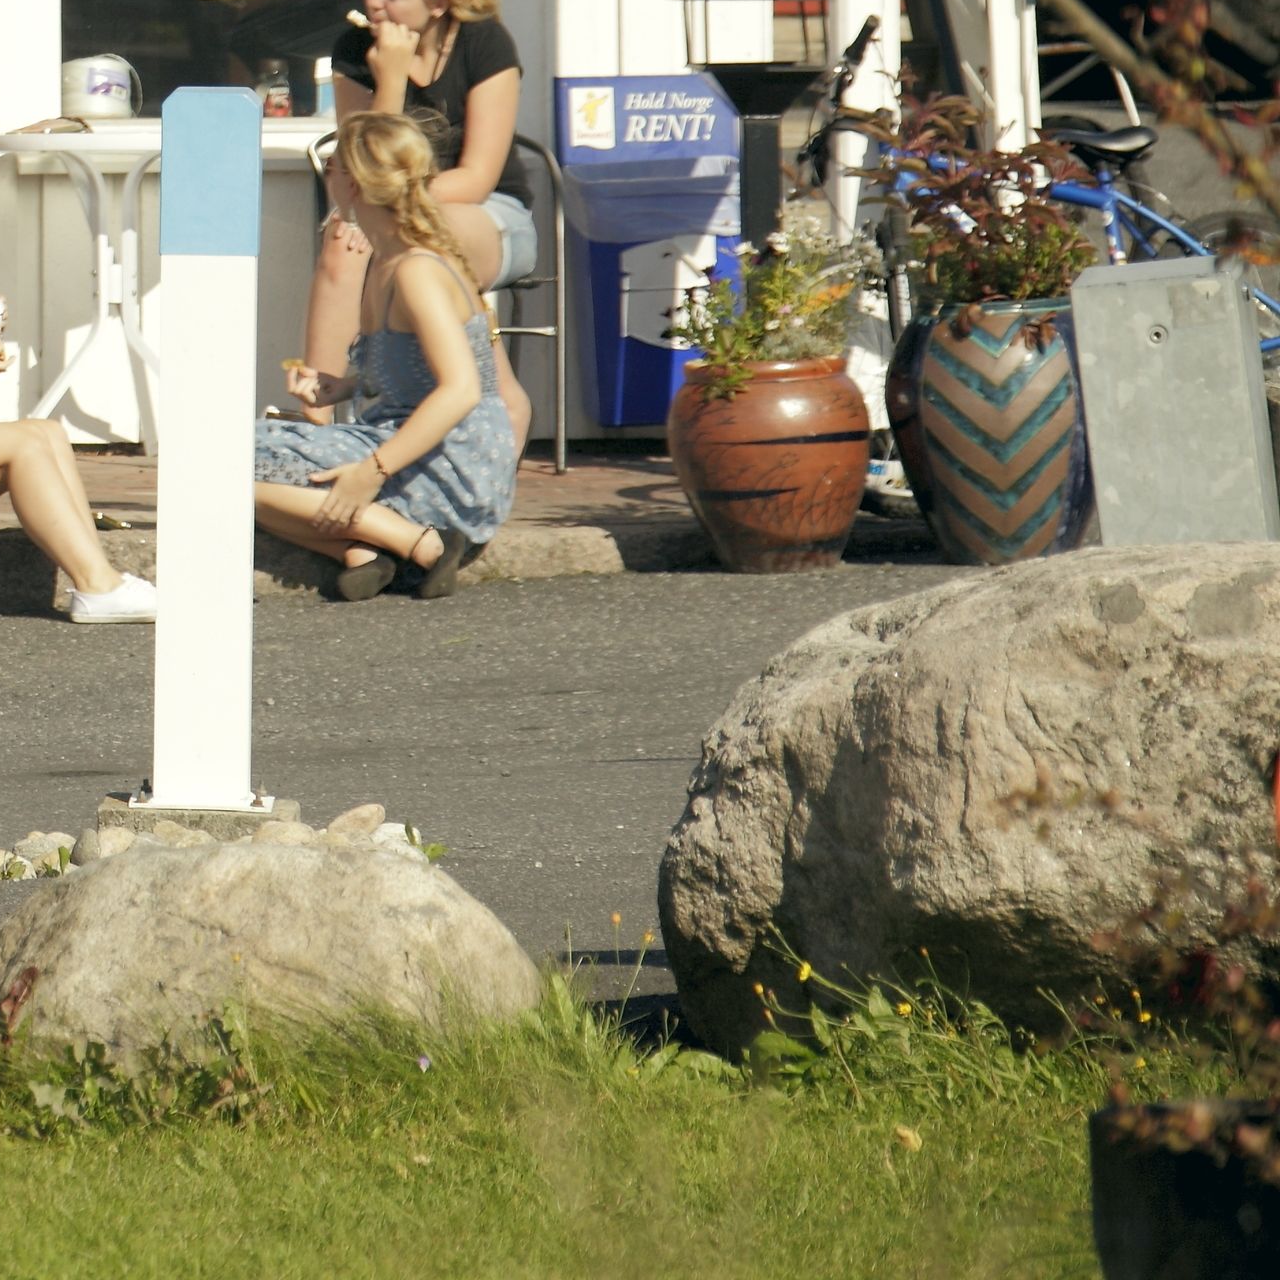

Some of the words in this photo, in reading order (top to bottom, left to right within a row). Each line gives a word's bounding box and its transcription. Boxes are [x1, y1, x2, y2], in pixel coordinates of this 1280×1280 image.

[623, 92, 667, 111] Hold
[667, 91, 714, 114] Norge
[623, 114, 716, 143] RENT!
